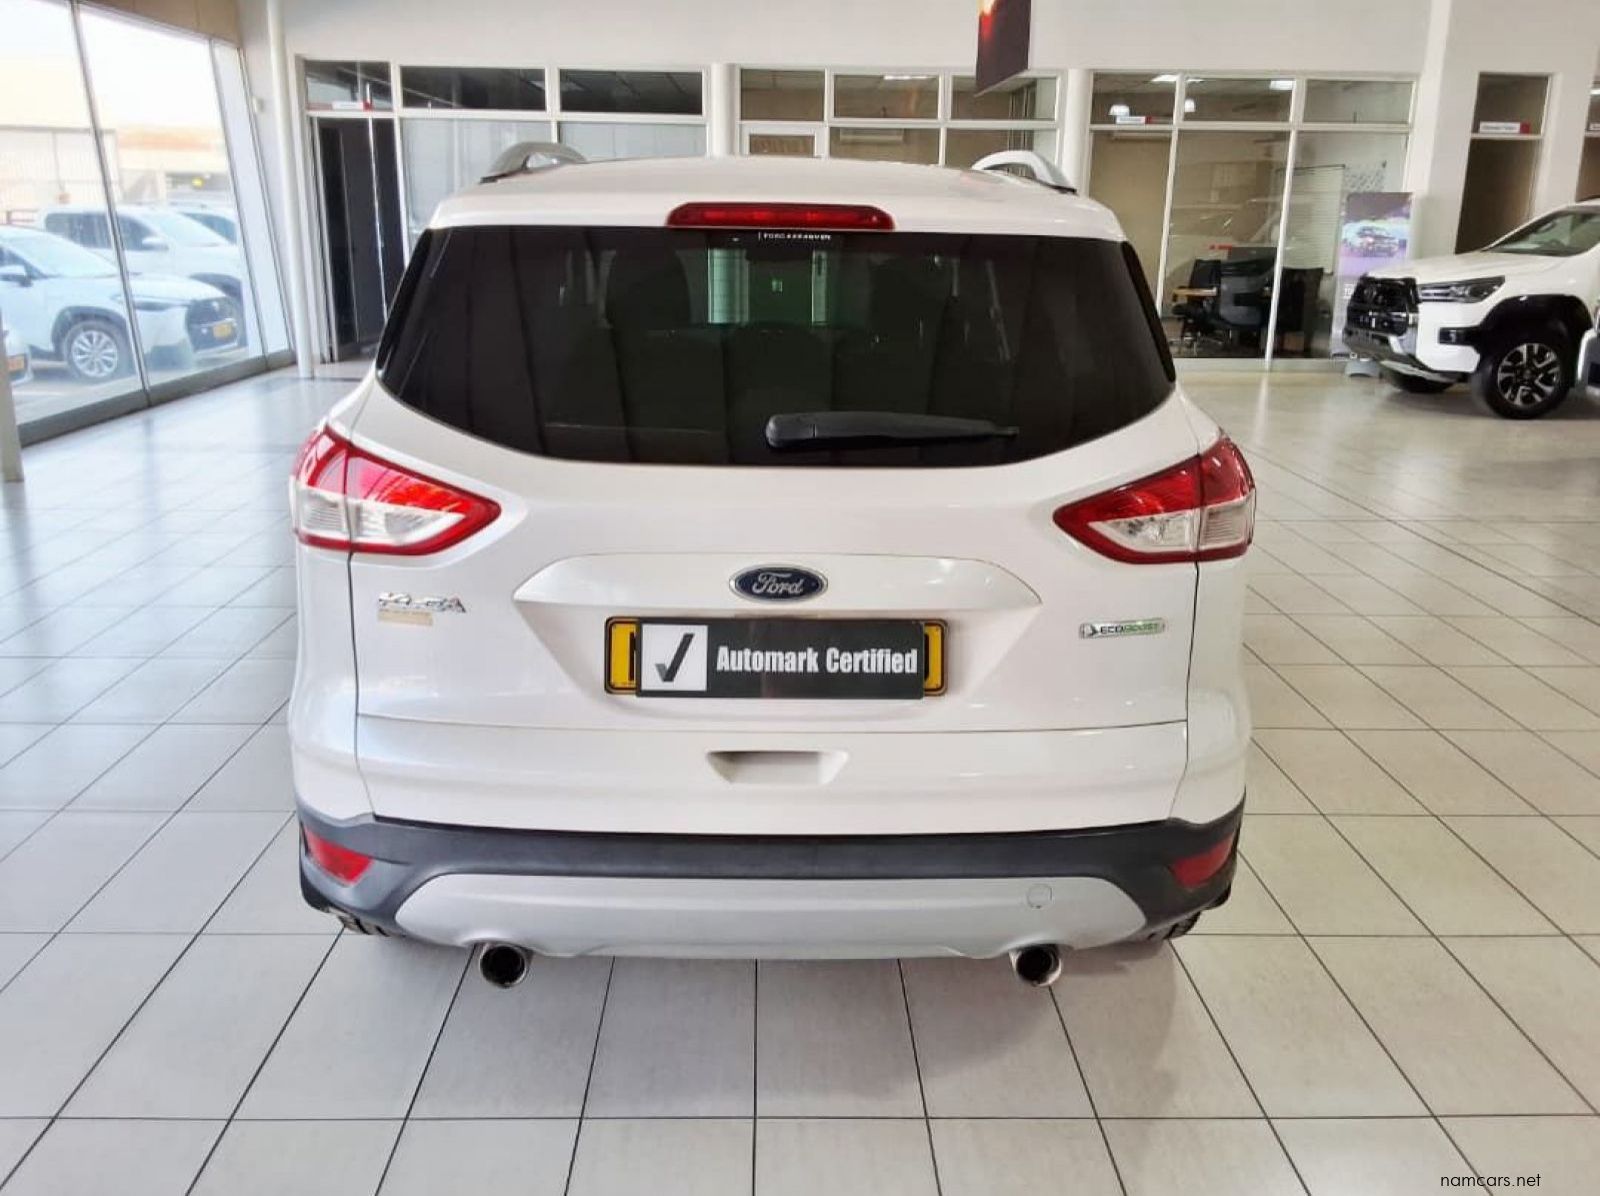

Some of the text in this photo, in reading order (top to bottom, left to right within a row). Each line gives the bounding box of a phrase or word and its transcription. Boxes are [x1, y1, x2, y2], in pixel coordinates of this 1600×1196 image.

[751, 571, 804, 594] Ford
[716, 645, 819, 673] Automark
[826, 646, 918, 673] Certified
